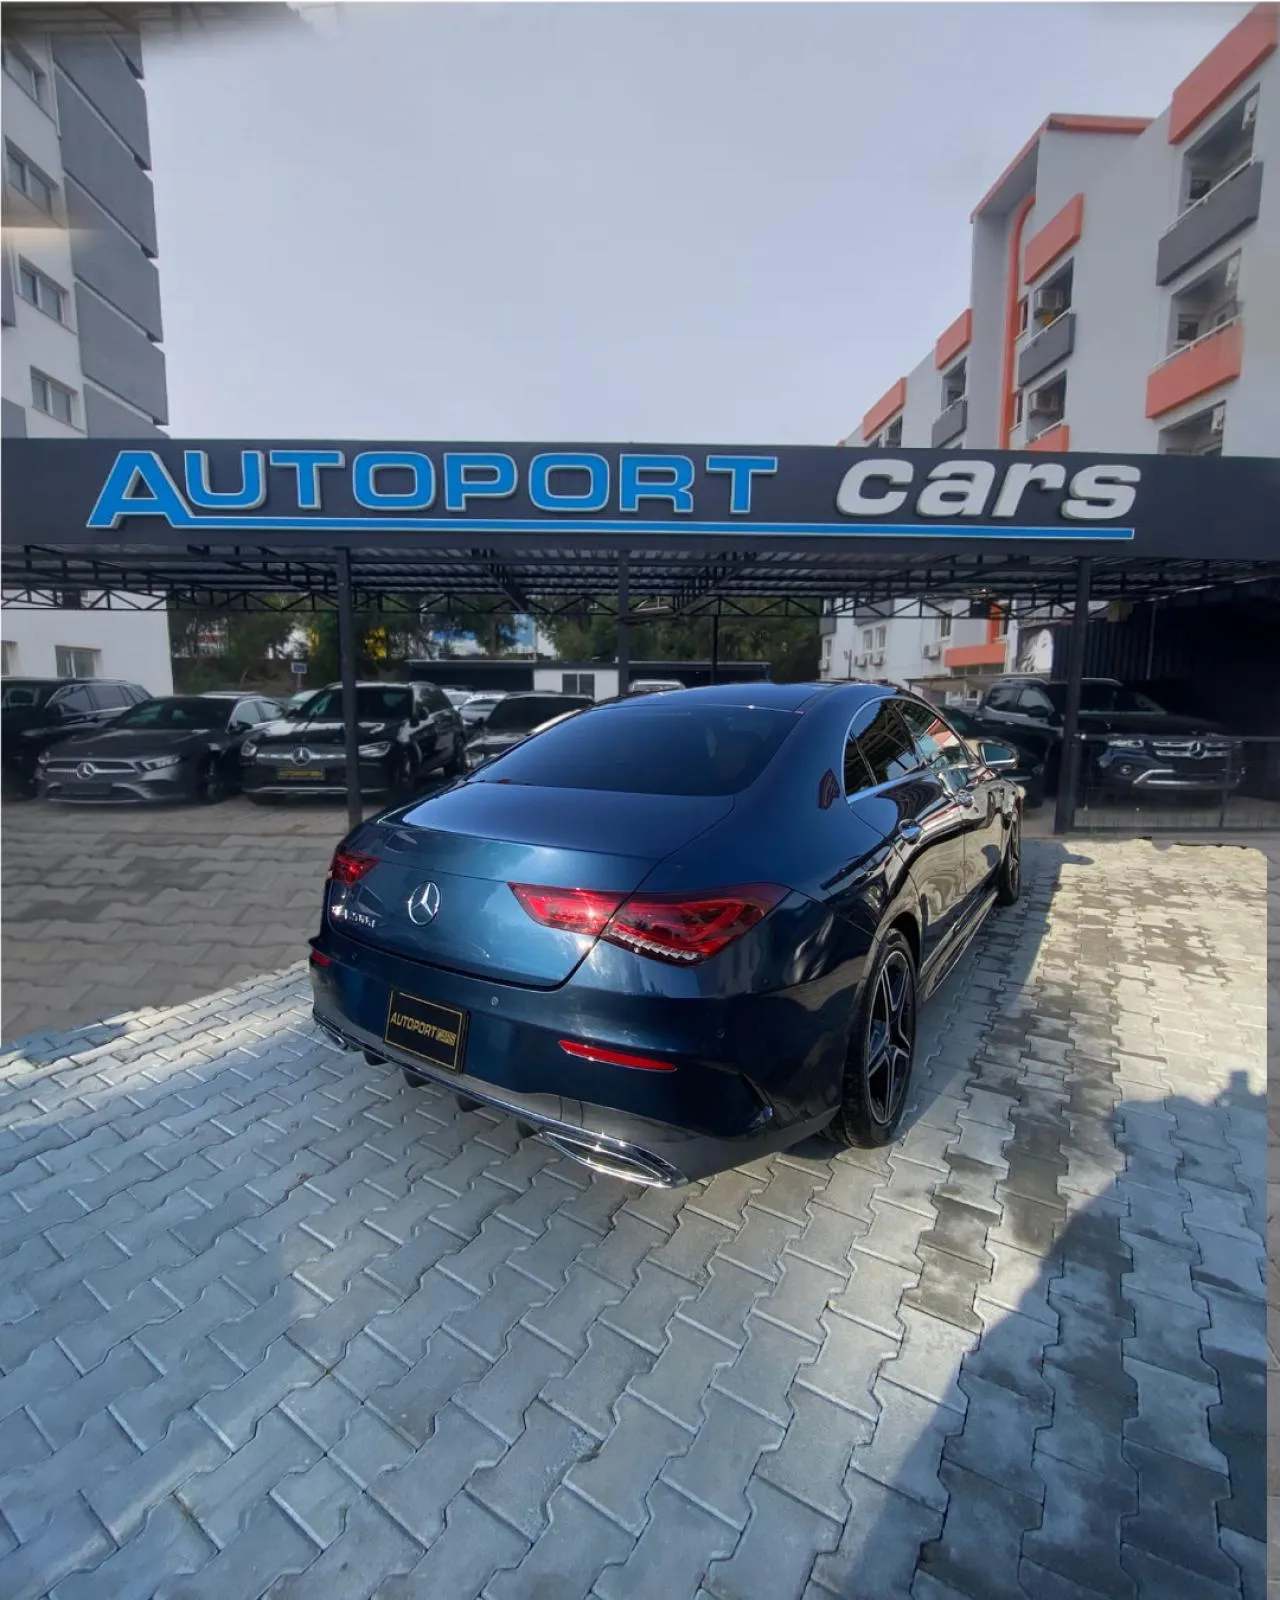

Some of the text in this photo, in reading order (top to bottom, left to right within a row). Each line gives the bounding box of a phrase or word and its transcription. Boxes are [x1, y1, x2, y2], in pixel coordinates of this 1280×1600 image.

[86, 449, 1142, 529] AUTOPORT cars
[390, 1012, 437, 1038] AUTOPORT
